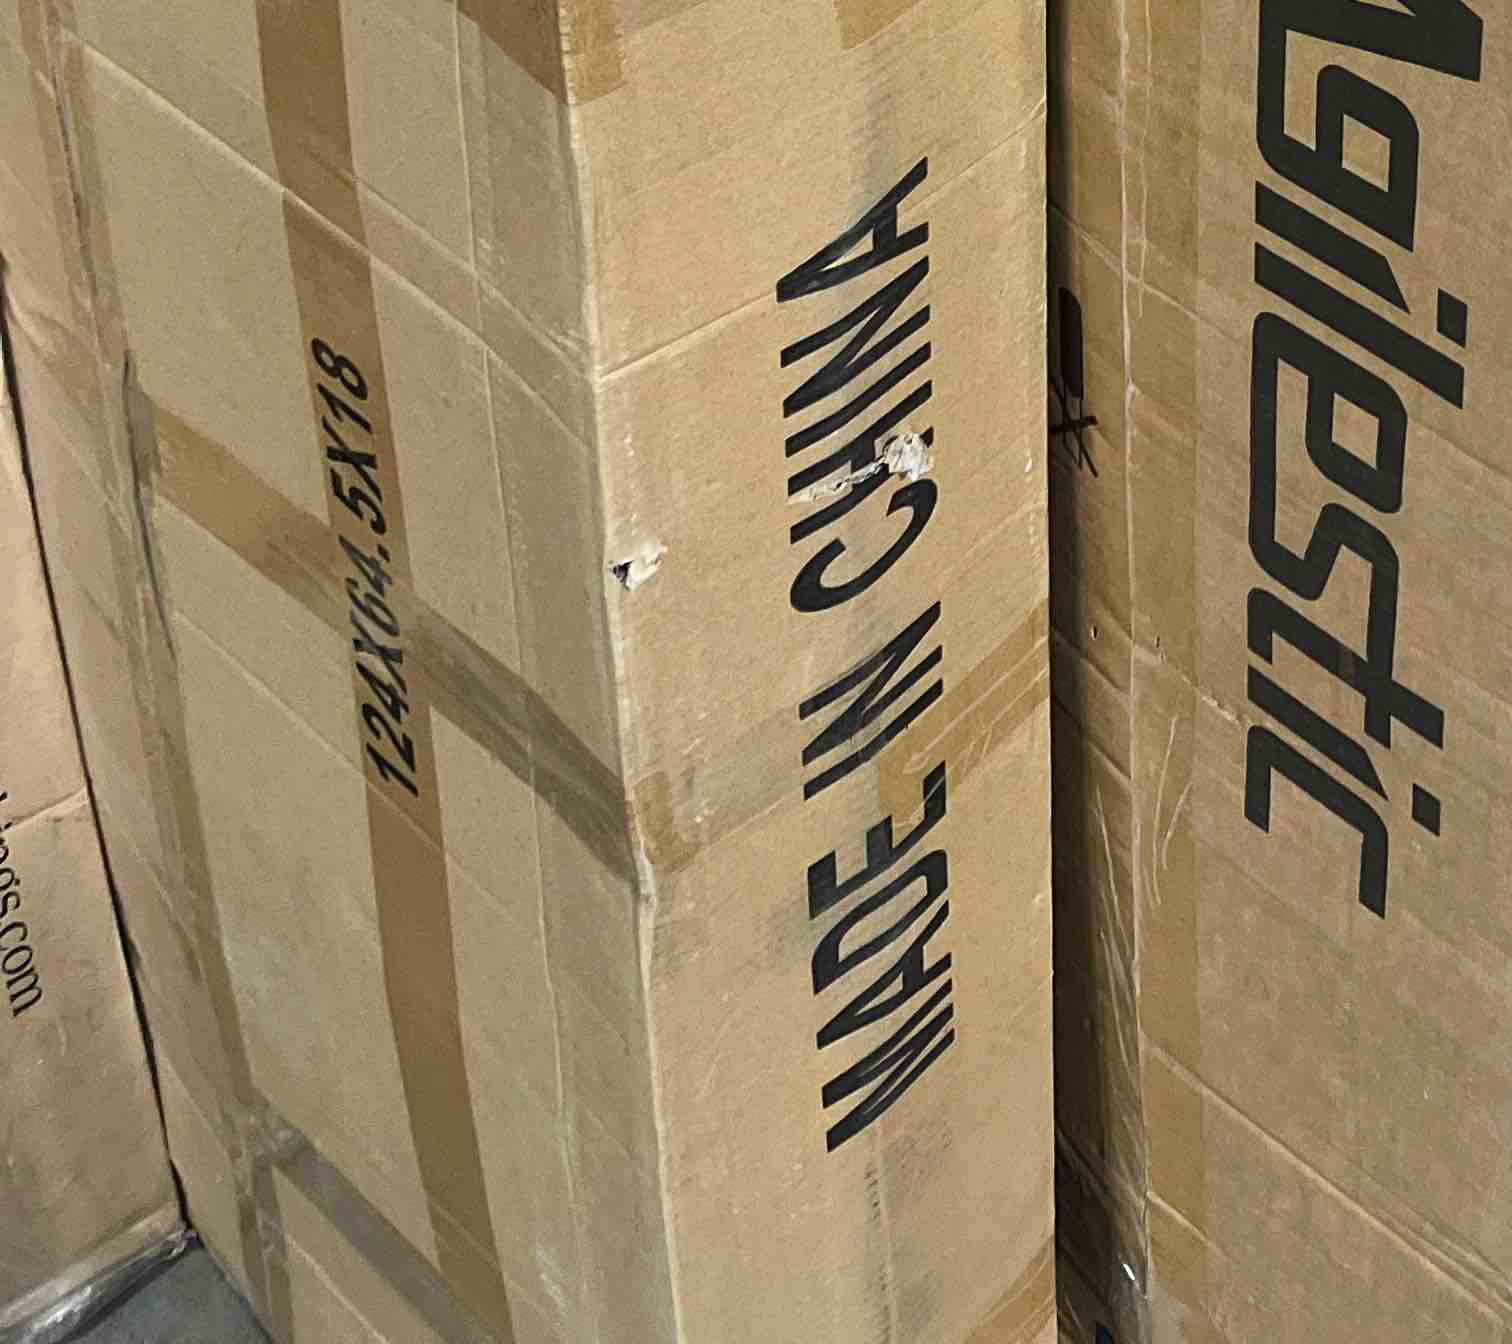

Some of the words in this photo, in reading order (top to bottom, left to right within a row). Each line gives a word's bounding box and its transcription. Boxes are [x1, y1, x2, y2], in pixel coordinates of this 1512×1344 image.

[776, 156, 941, 614] CHINA
[799, 598, 944, 802] IN
[807, 760, 958, 1153] MADE
